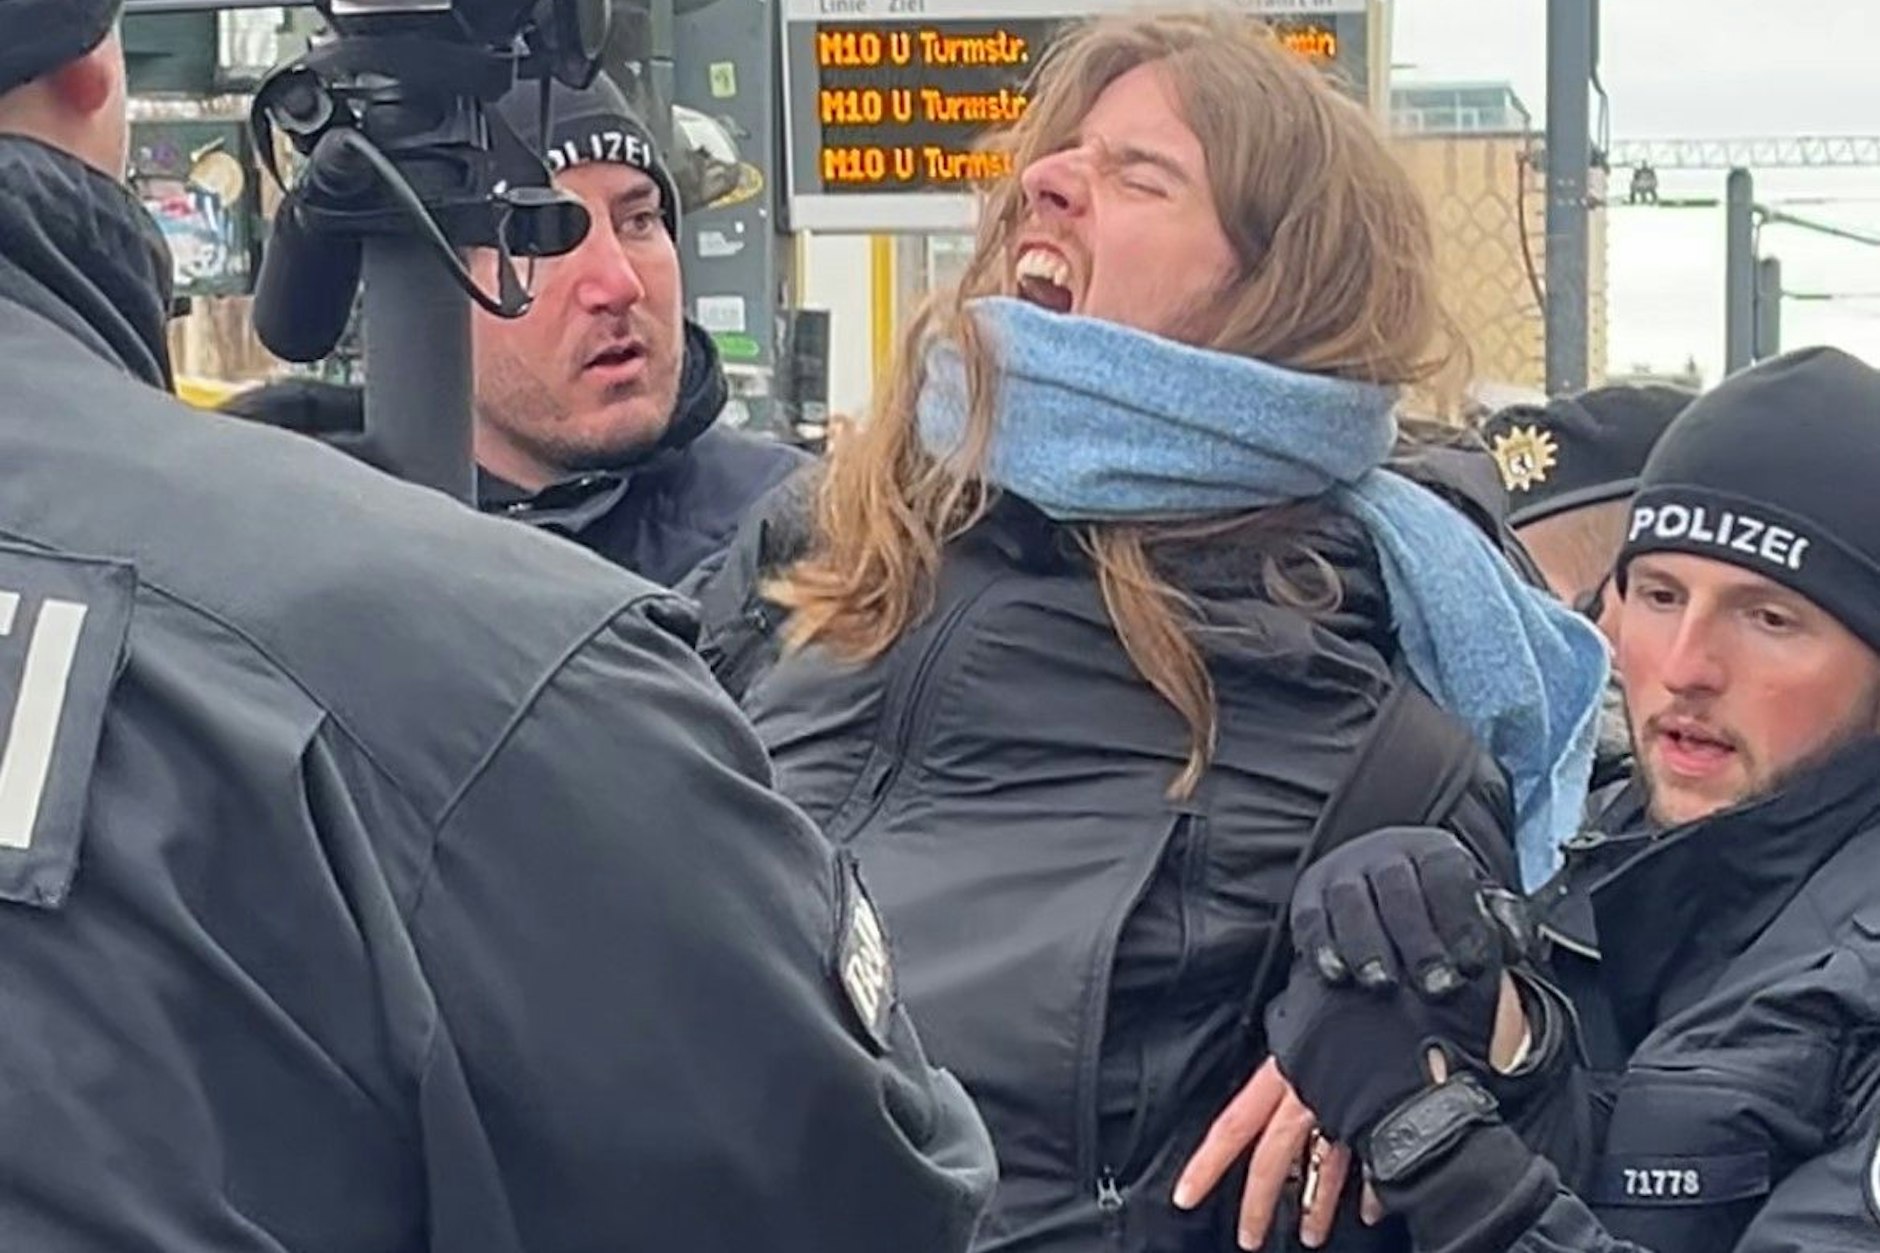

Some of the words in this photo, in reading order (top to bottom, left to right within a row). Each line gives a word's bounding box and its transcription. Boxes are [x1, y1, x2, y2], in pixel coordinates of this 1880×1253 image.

[819, 31, 879, 65] M10
[890, 31, 910, 64] U
[920, 30, 1029, 64] Turmstr.
[821, 90, 881, 122] M10
[892, 89, 912, 121] U
[921, 88, 1027, 121] Turmstr
[824, 148, 885, 180] M10
[895, 148, 914, 179] U
[1628, 503, 1810, 569] POLIZEI
[1623, 1169, 1700, 1195] 71778
